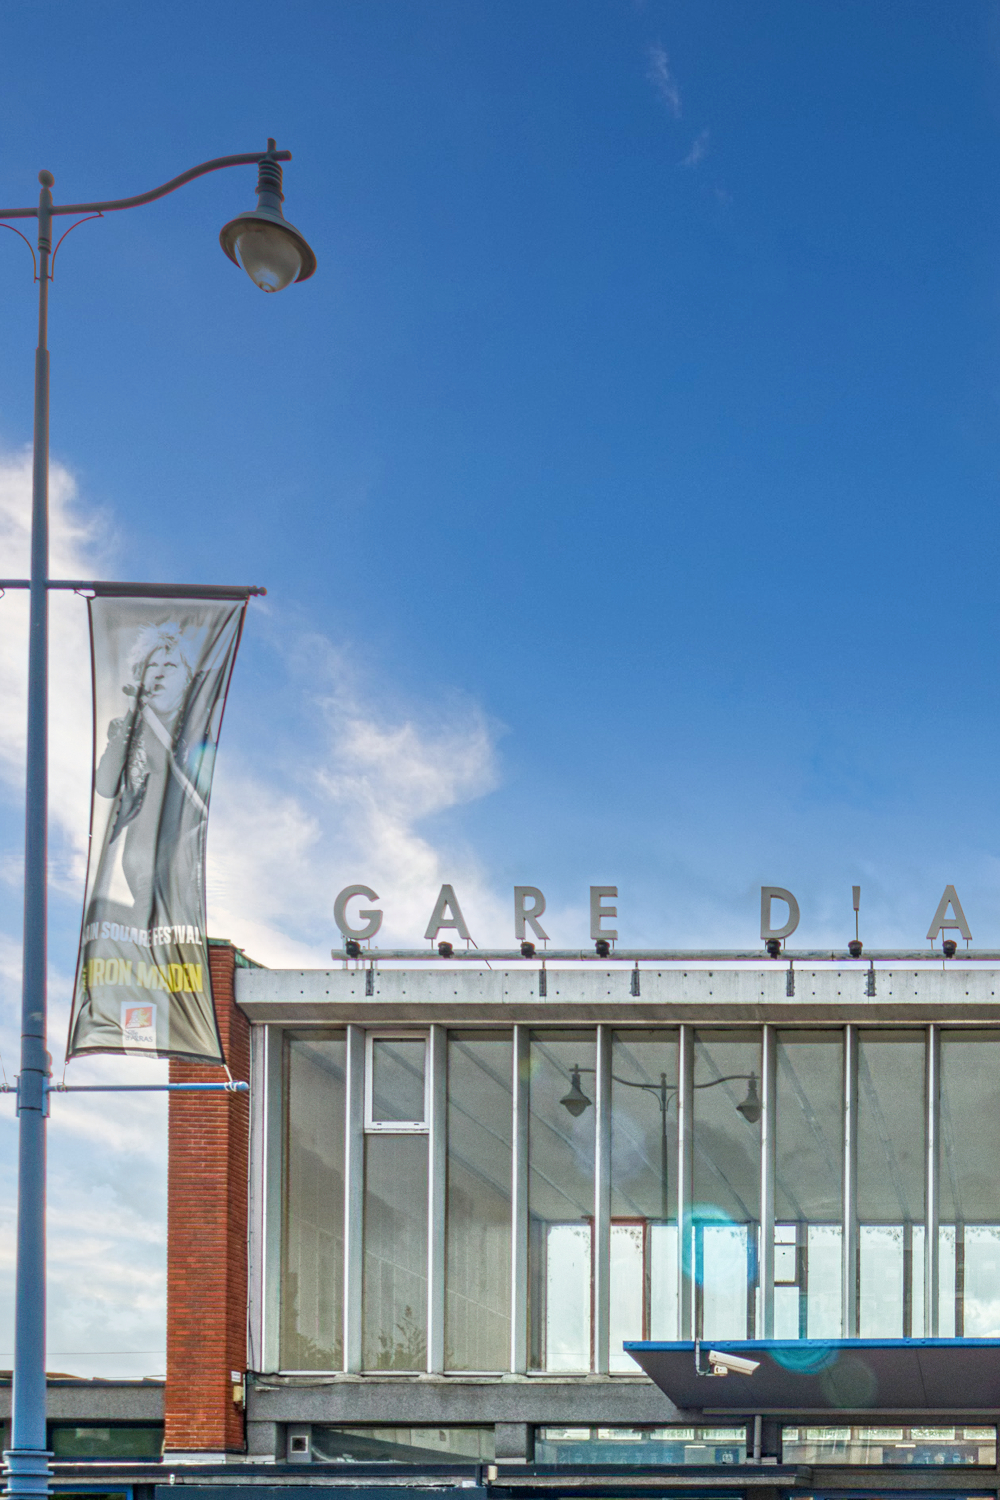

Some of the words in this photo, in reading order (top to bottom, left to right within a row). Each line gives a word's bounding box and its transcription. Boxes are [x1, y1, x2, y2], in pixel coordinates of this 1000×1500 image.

[333, 883, 619, 940] GARE
[101, 921, 152, 948] SQUARE
[88, 958, 133, 987] IRON
[136, 960, 204, 993] MAIDEN
